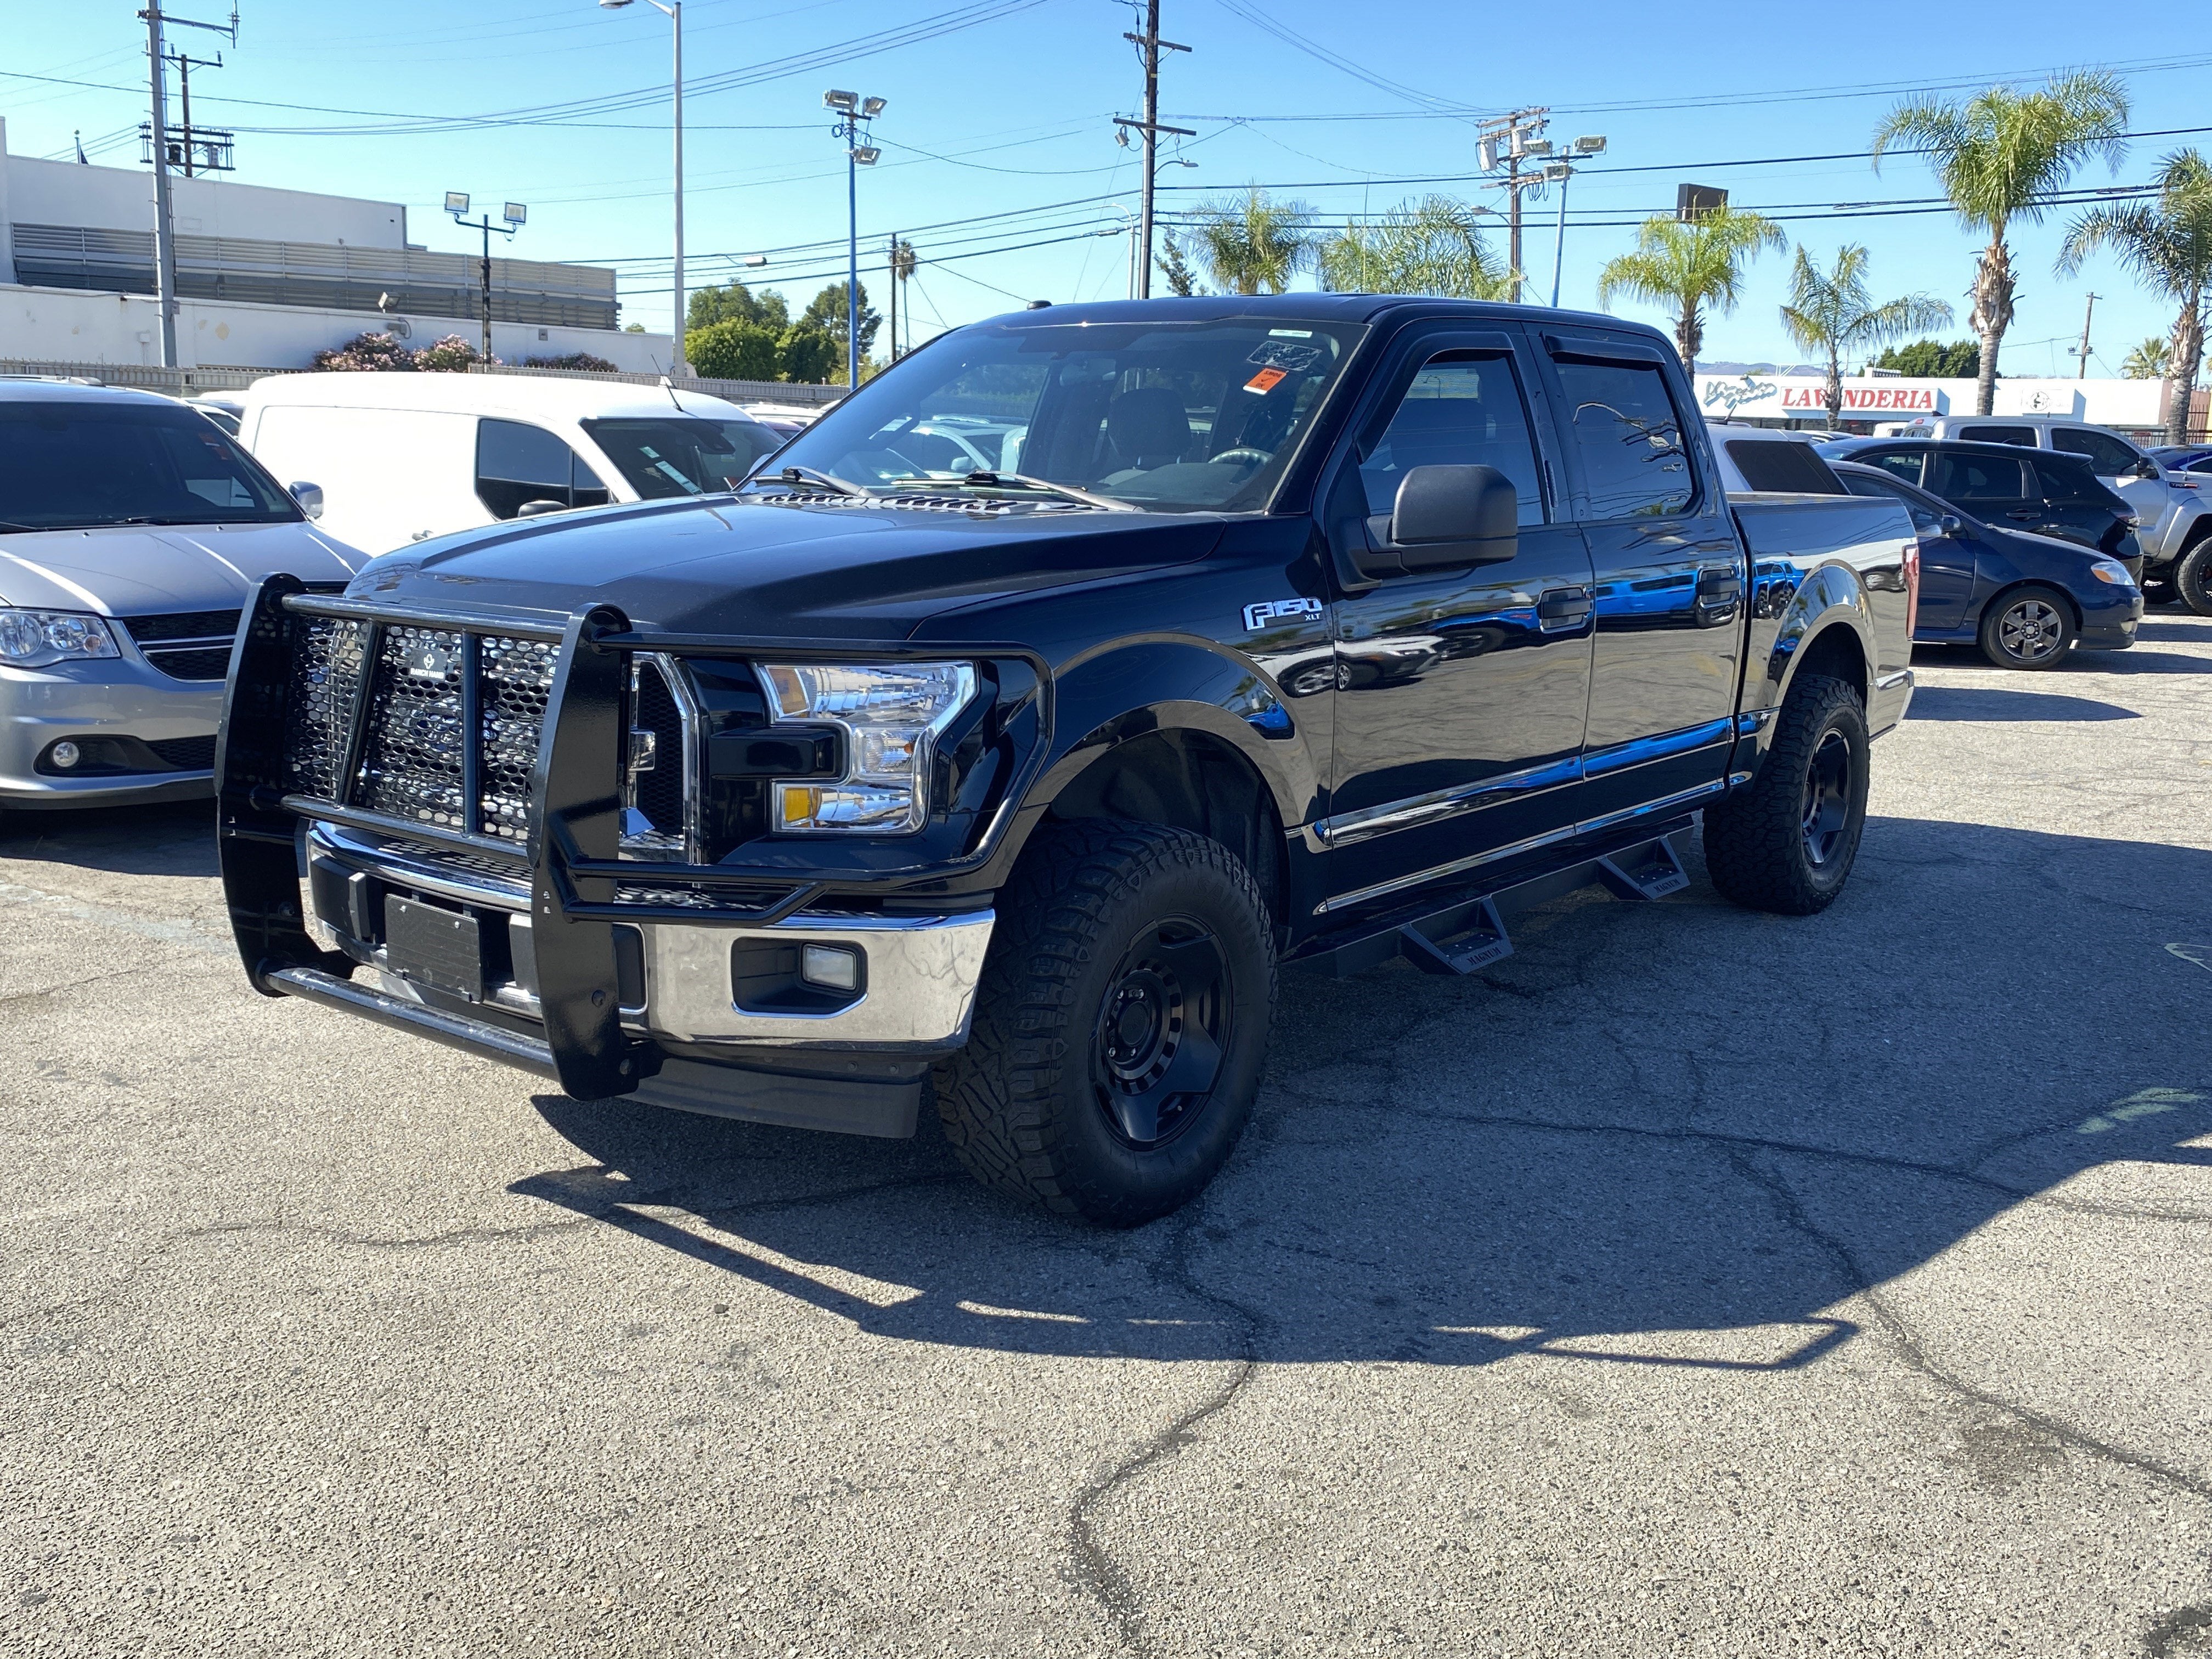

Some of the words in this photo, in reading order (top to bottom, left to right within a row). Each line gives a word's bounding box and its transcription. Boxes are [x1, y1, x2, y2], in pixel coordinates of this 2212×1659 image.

[1782, 388, 1933, 409] LAVNDERIA
[410, 668, 429, 677] RANCH
[428, 670, 444, 679] HAND
[1653, 878, 1680, 893] MAGNUM
[1466, 946, 1502, 966] MAGNUM
